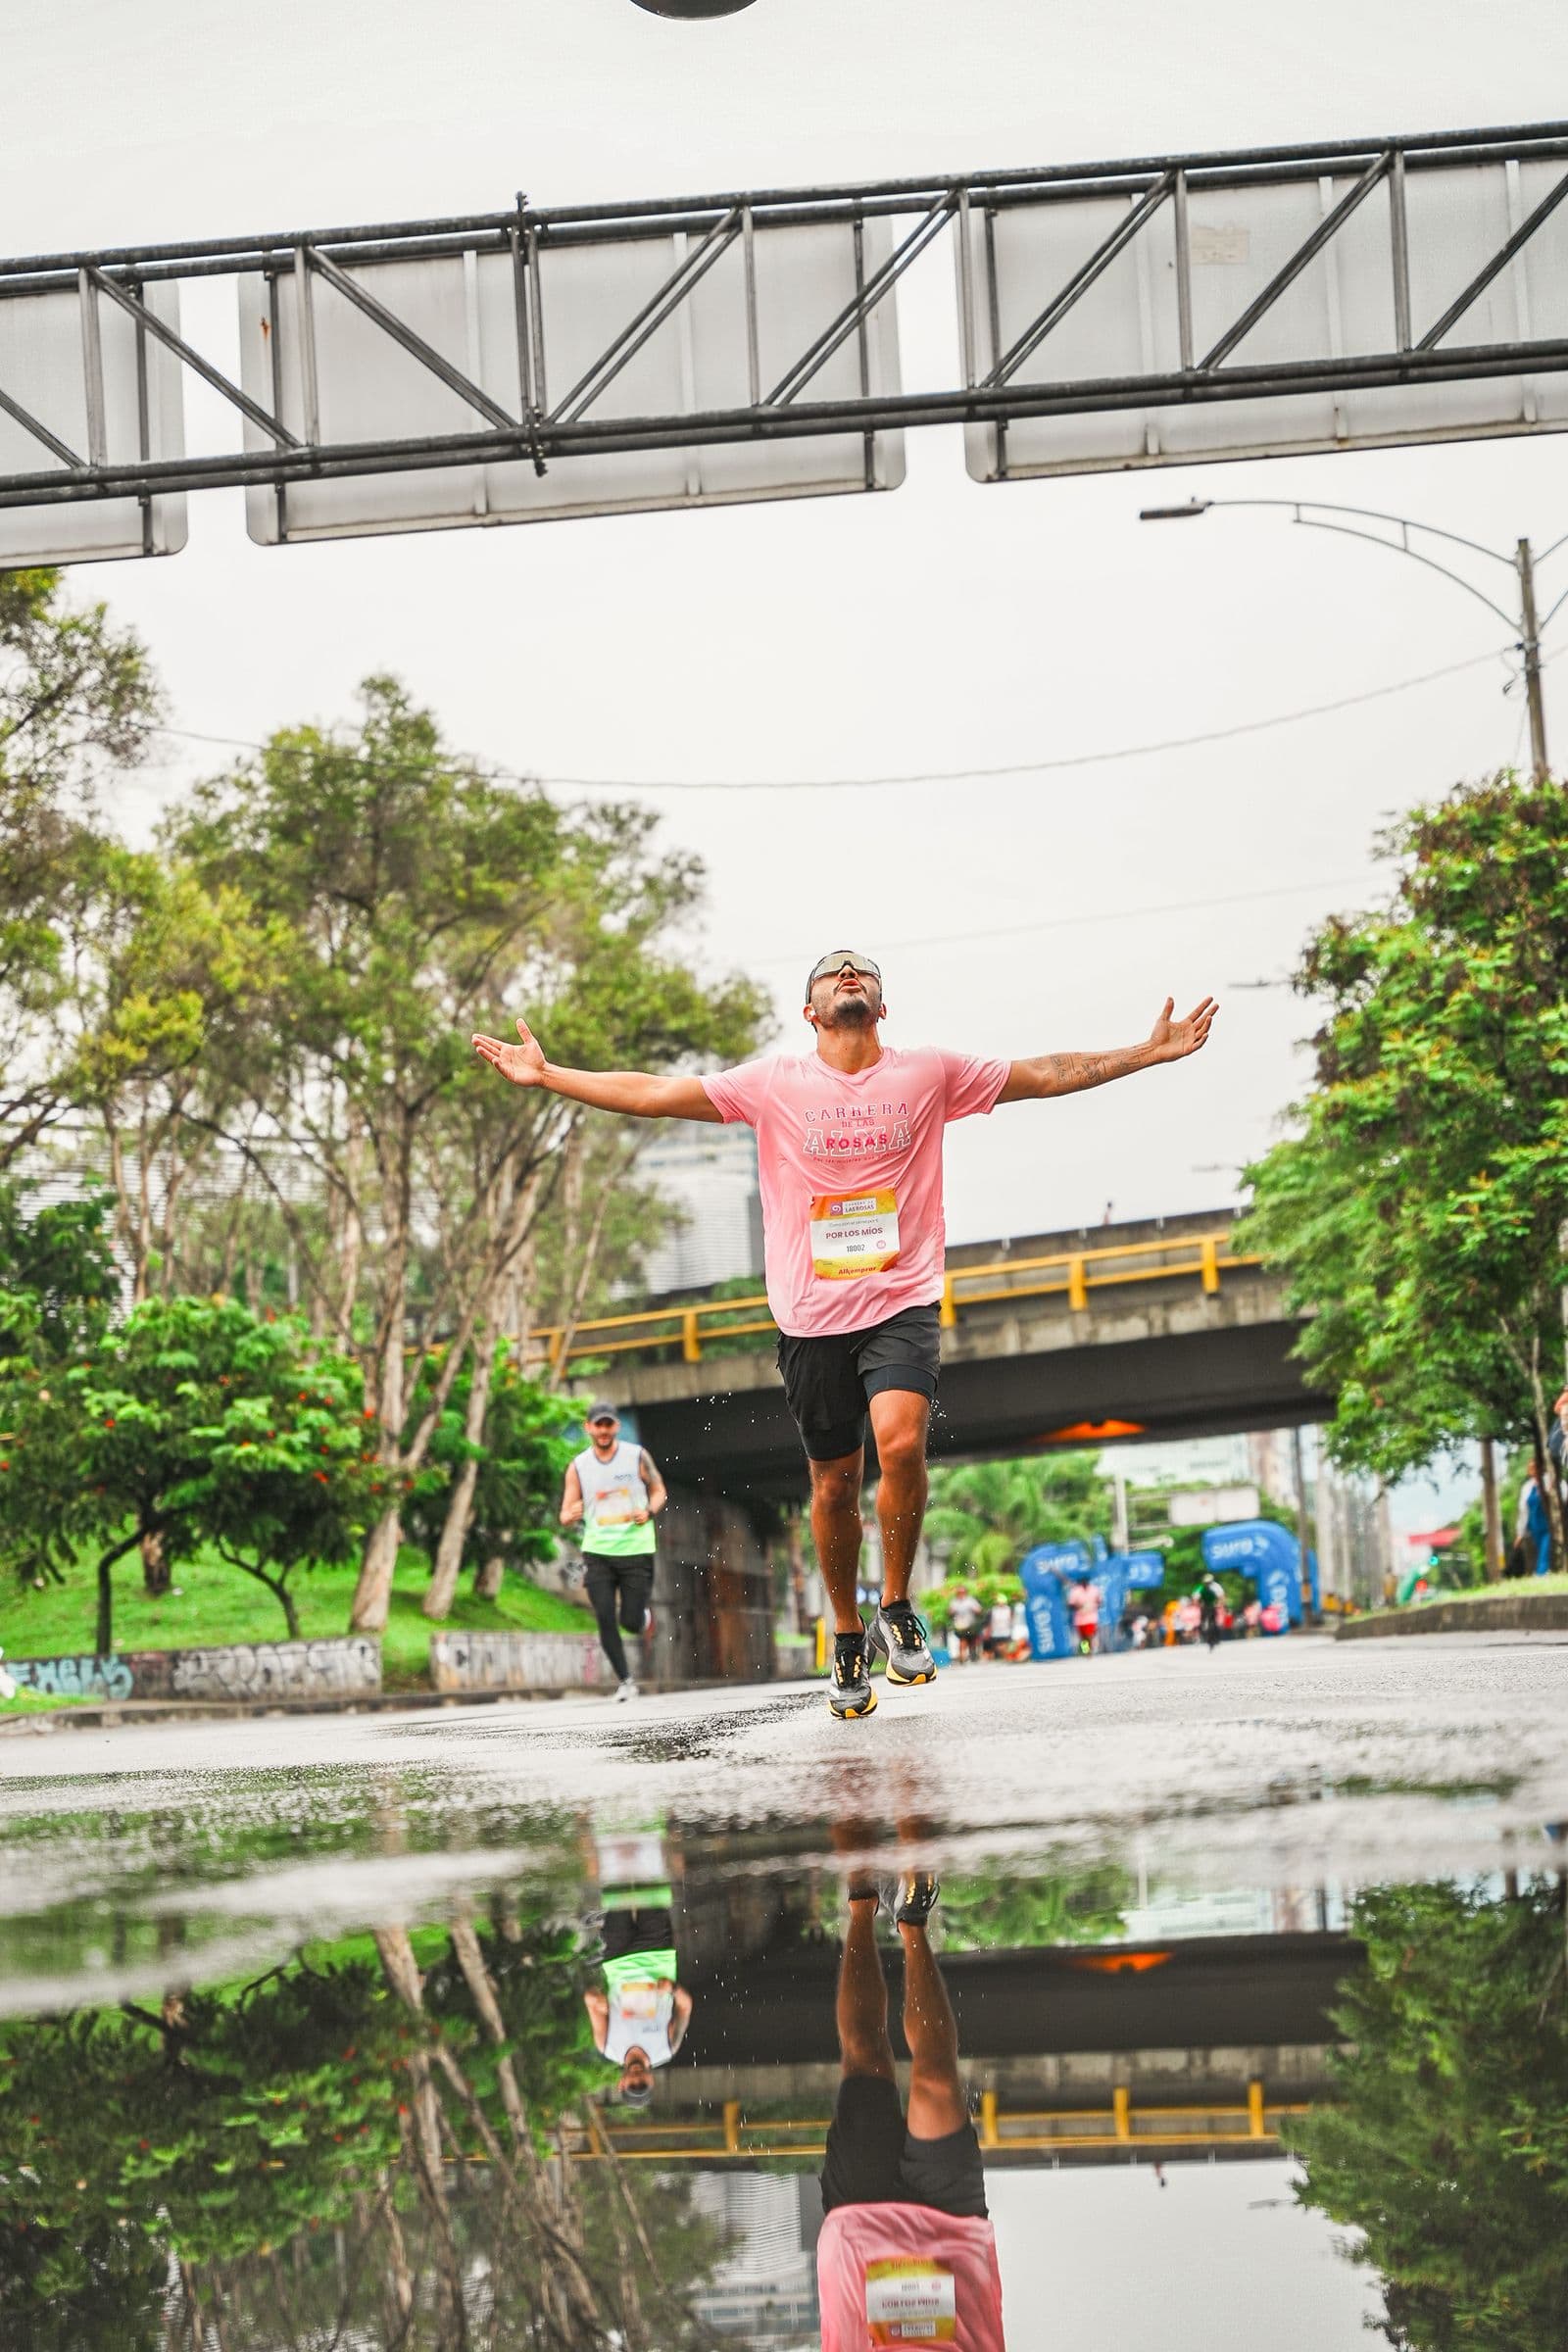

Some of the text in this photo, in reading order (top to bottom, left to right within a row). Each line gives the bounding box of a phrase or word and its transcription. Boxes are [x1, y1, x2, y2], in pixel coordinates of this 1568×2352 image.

[805, 1102, 909, 1123] CARRERA
[803, 1120, 911, 1156] ALMA
[826, 1134, 888, 1149] ROSAS
[826, 1227, 883, 1240] POR LOS MÍOS
